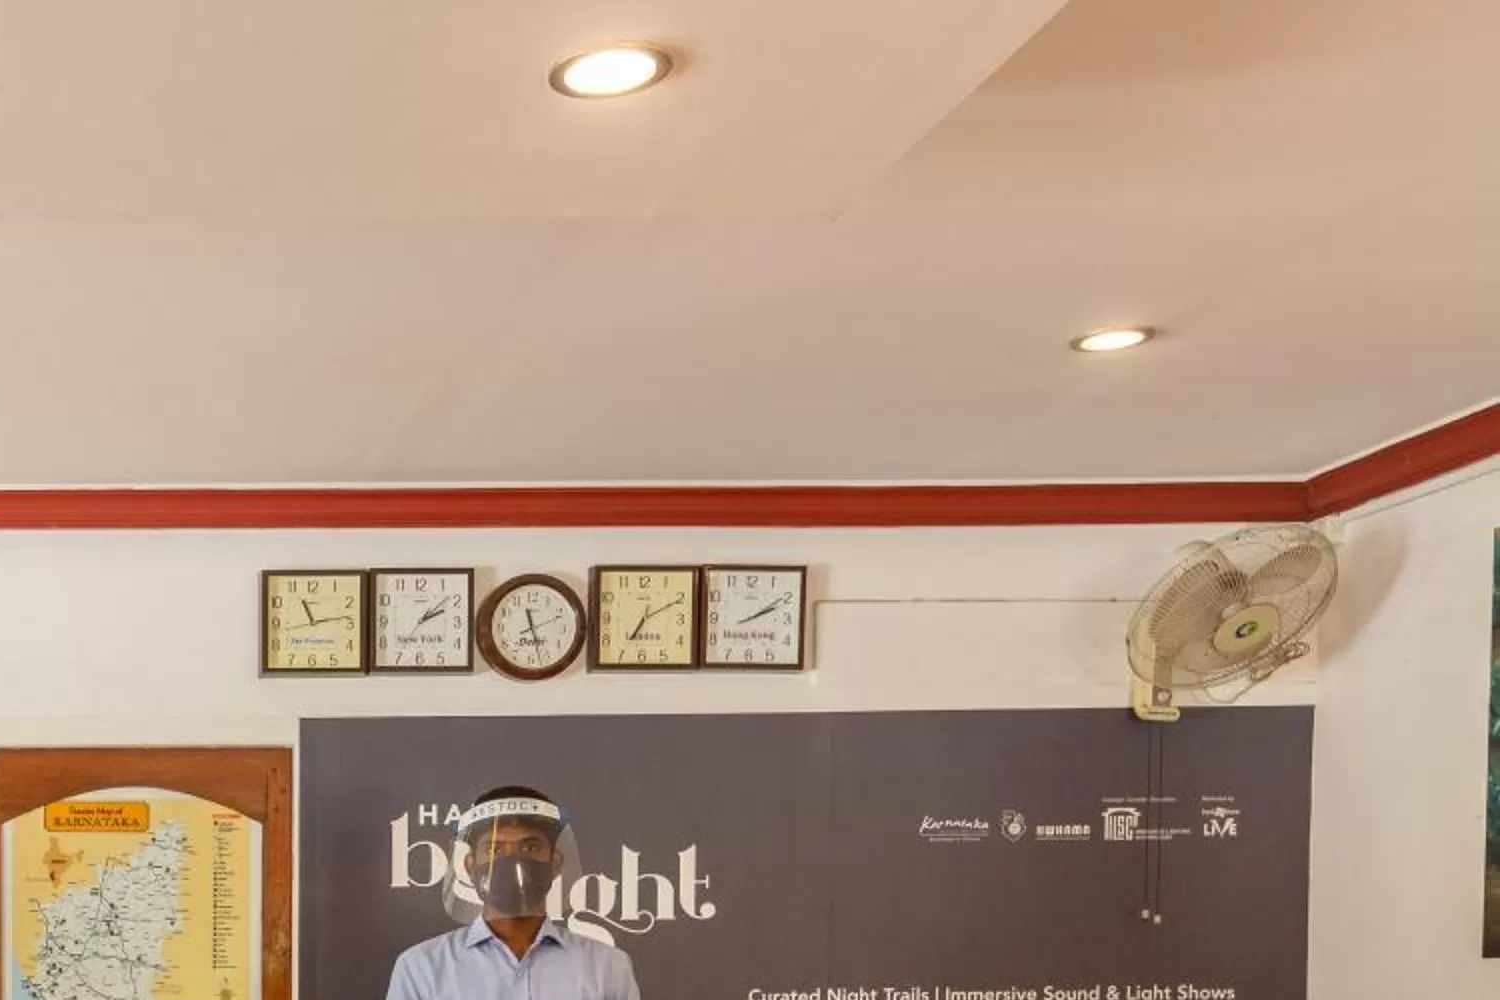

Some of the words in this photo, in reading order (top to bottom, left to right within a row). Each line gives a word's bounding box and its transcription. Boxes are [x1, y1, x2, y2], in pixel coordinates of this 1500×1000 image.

[54, 816, 141, 827] KARNATAKA
[418, 803, 474, 826] HA
[919, 815, 989, 833] Karnataka
[546, 843, 717, 947] ight
[1106, 985, 1120, 1000] &
[1177, 984, 1235, 1000] Shows
